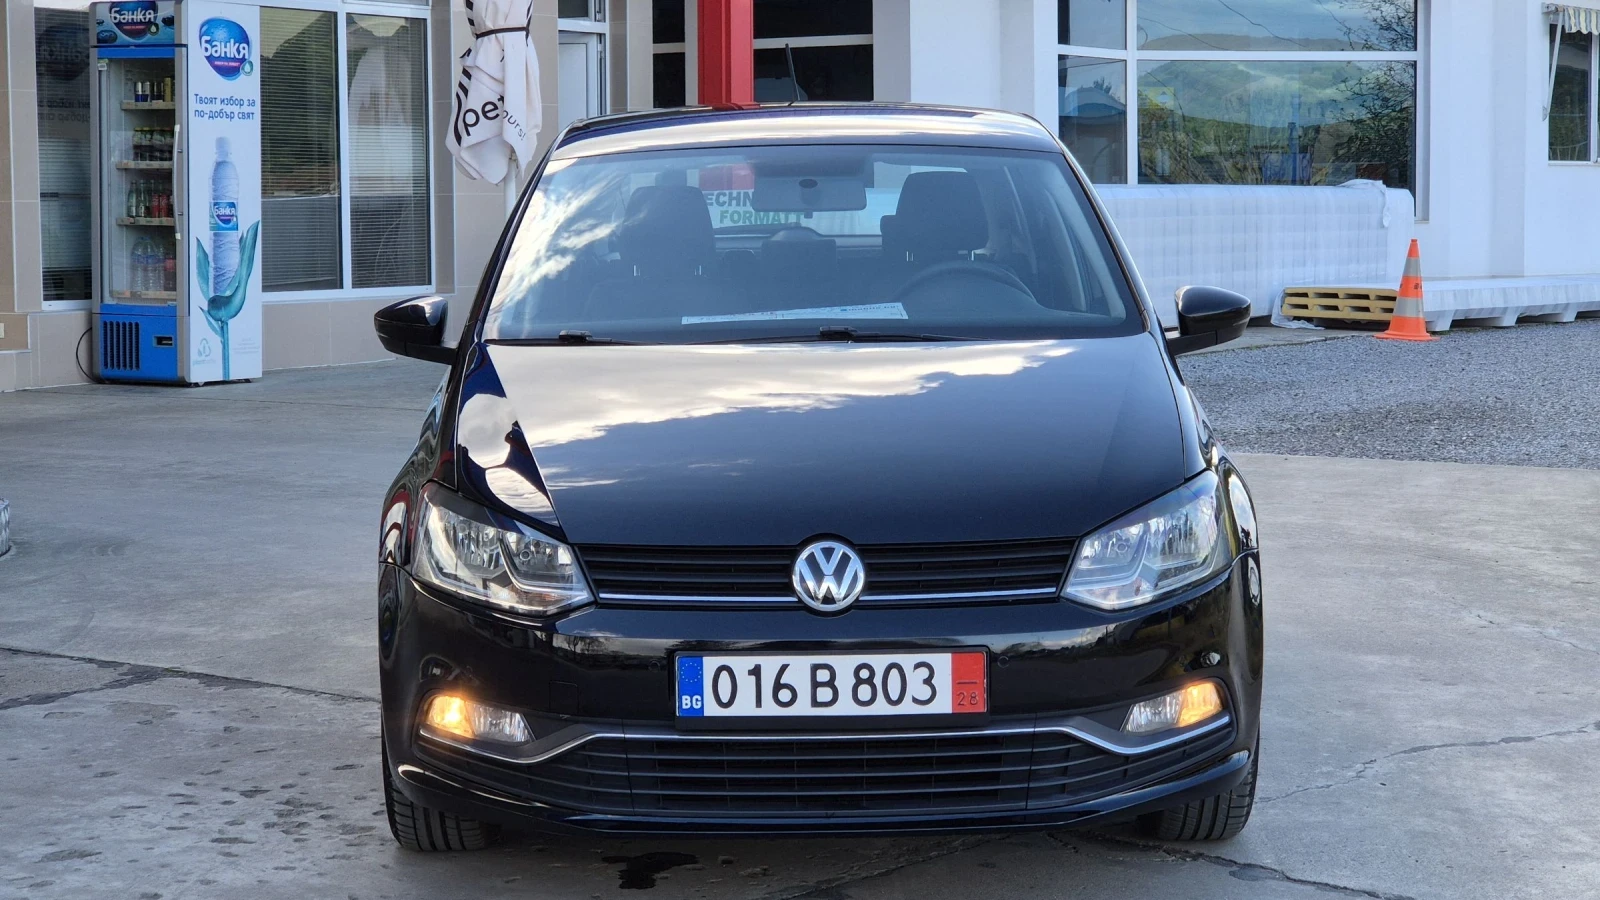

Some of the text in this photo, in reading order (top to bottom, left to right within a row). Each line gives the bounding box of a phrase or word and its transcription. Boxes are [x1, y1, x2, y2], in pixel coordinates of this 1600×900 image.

[201, 35, 249, 59] Банкя
[193, 93, 256, 108] Твоят избор за
[194, 109, 255, 122] по-добър свят
[793, 542, 865, 612] VW
[681, 694, 702, 710] BG
[956, 691, 979, 707] 28
